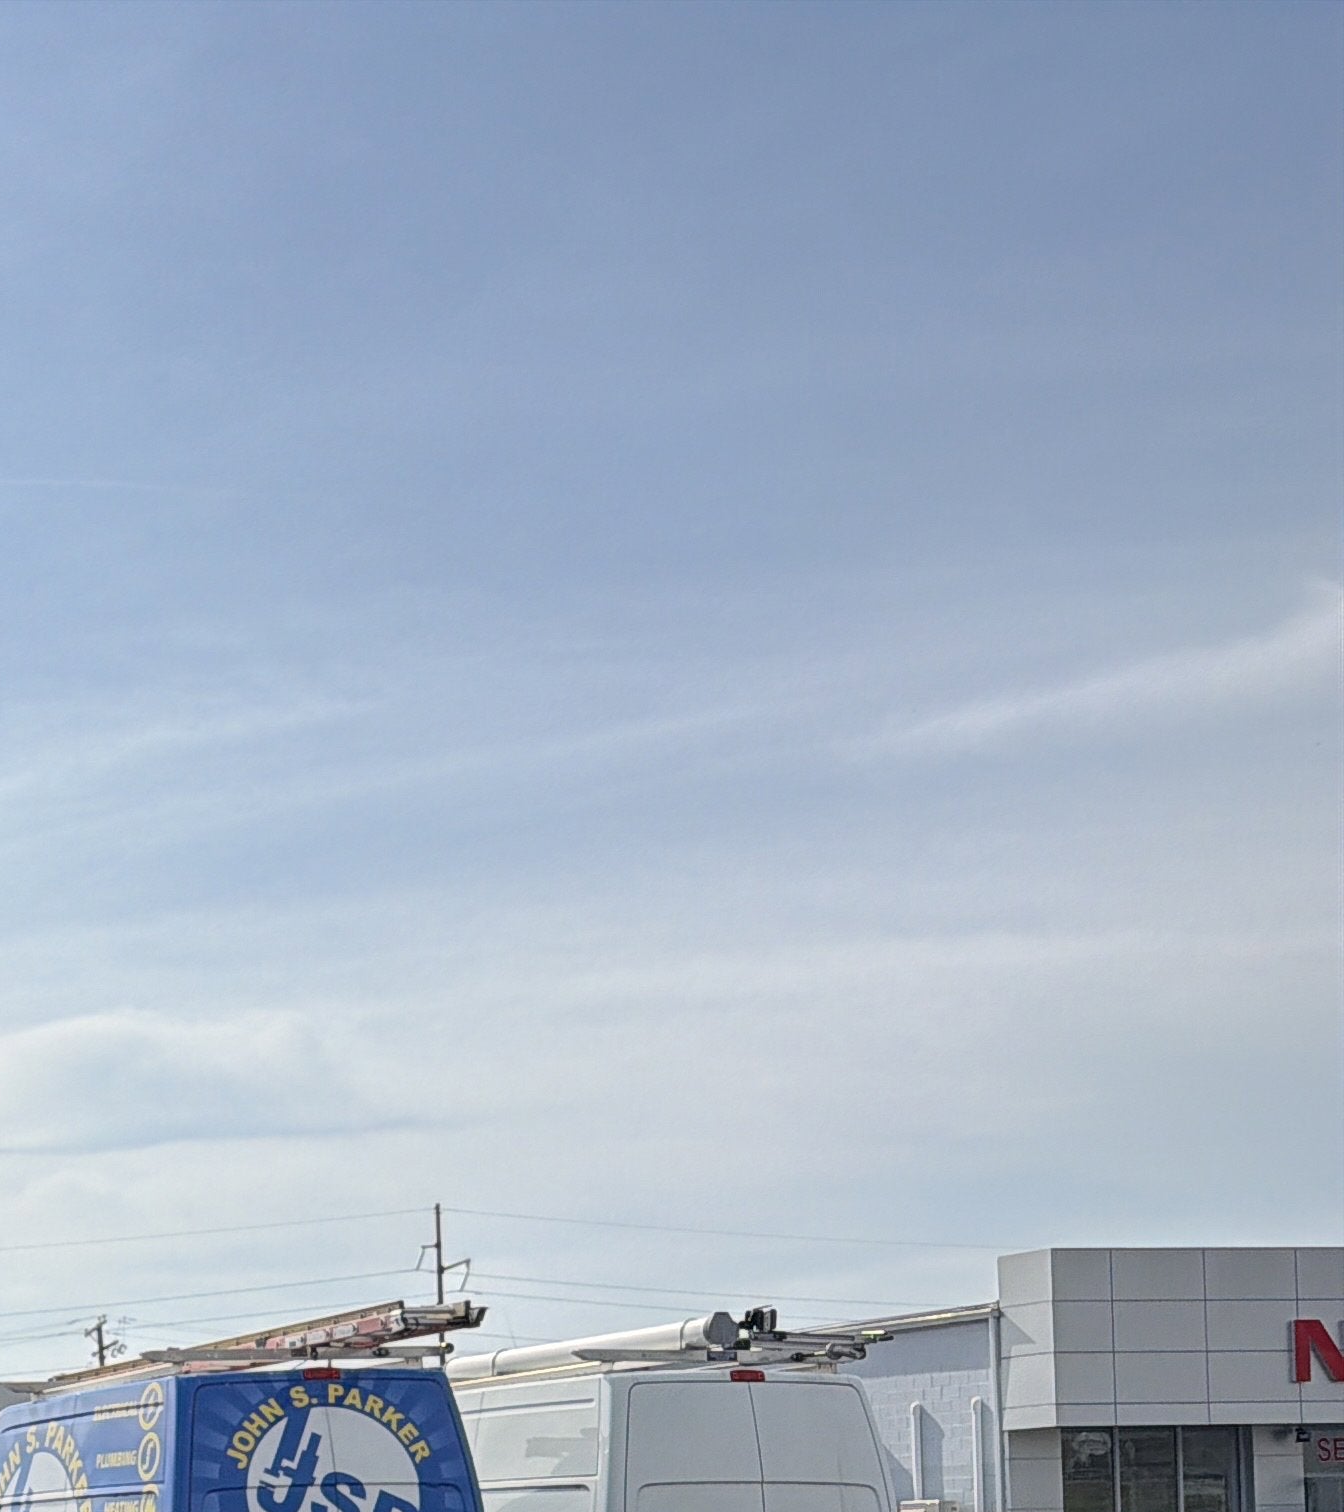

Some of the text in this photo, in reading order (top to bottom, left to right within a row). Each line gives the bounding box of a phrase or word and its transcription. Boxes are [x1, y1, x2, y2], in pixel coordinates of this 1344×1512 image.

[226, 1384, 431, 1470] JOHN S. PARKER
[95, 1450, 137, 1469] PLUMBING
